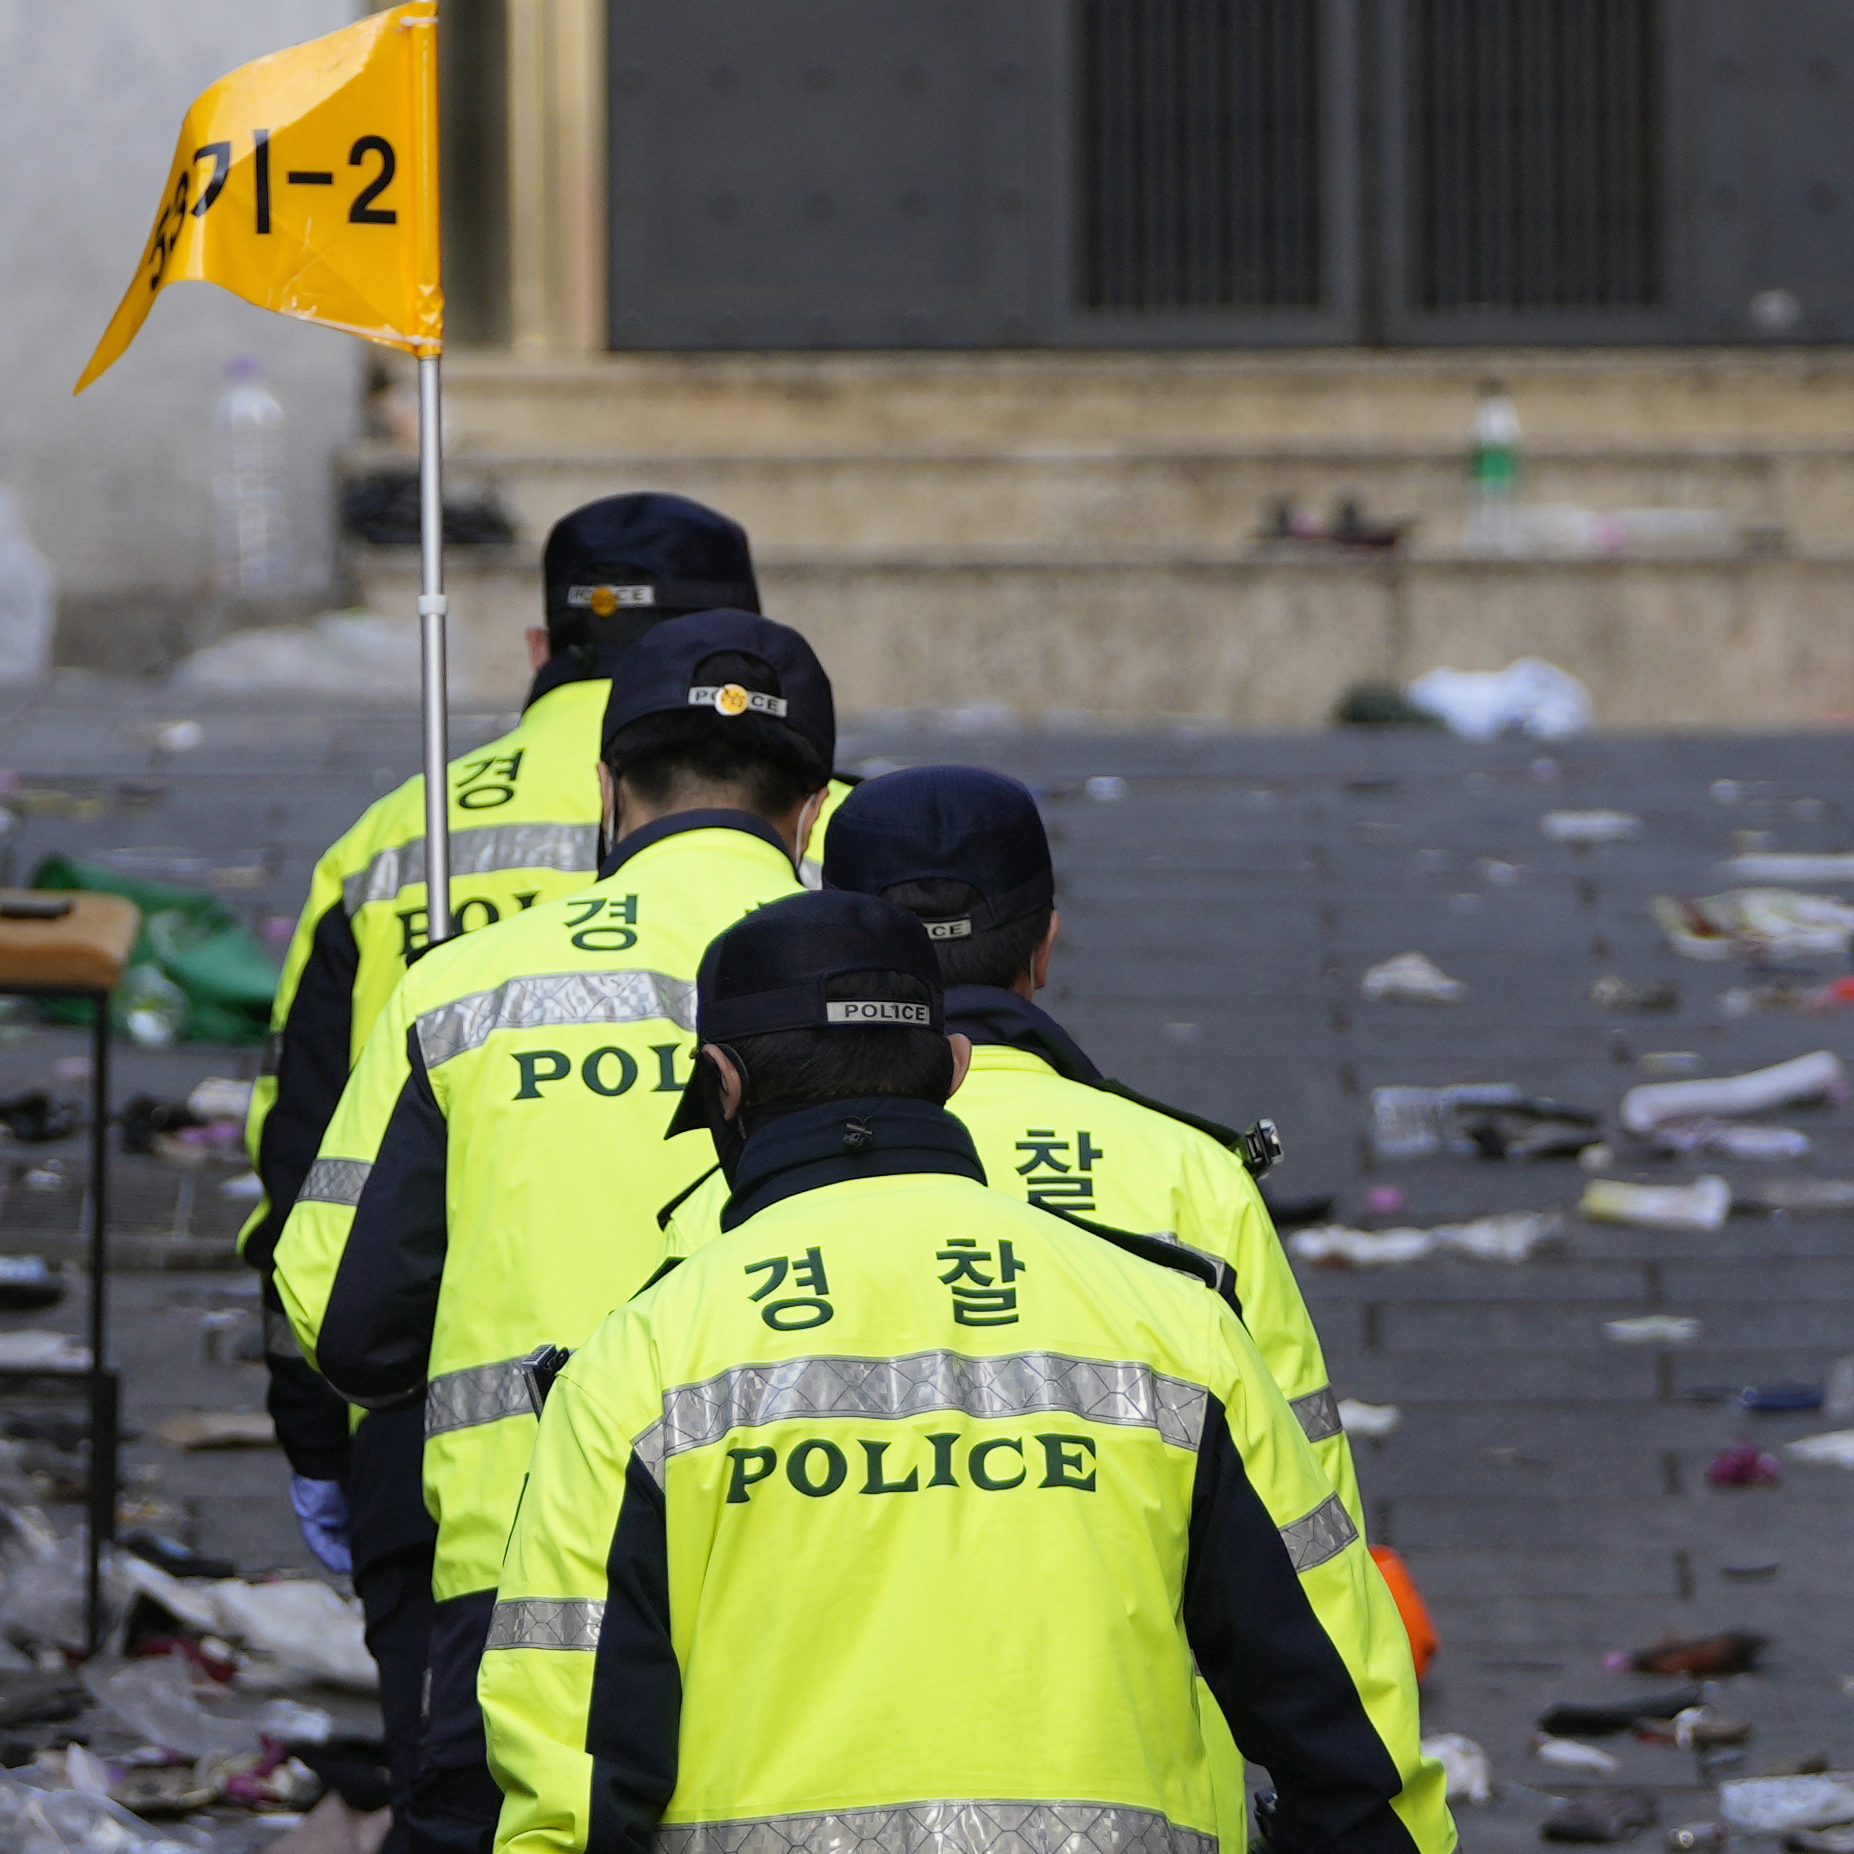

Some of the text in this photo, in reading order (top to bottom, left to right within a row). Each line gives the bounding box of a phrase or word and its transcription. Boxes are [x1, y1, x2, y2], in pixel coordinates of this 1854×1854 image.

[845, 1003, 926, 1021] POLICE
[510, 1044, 696, 1102] POL
[724, 1432, 1099, 1505] POLICE
